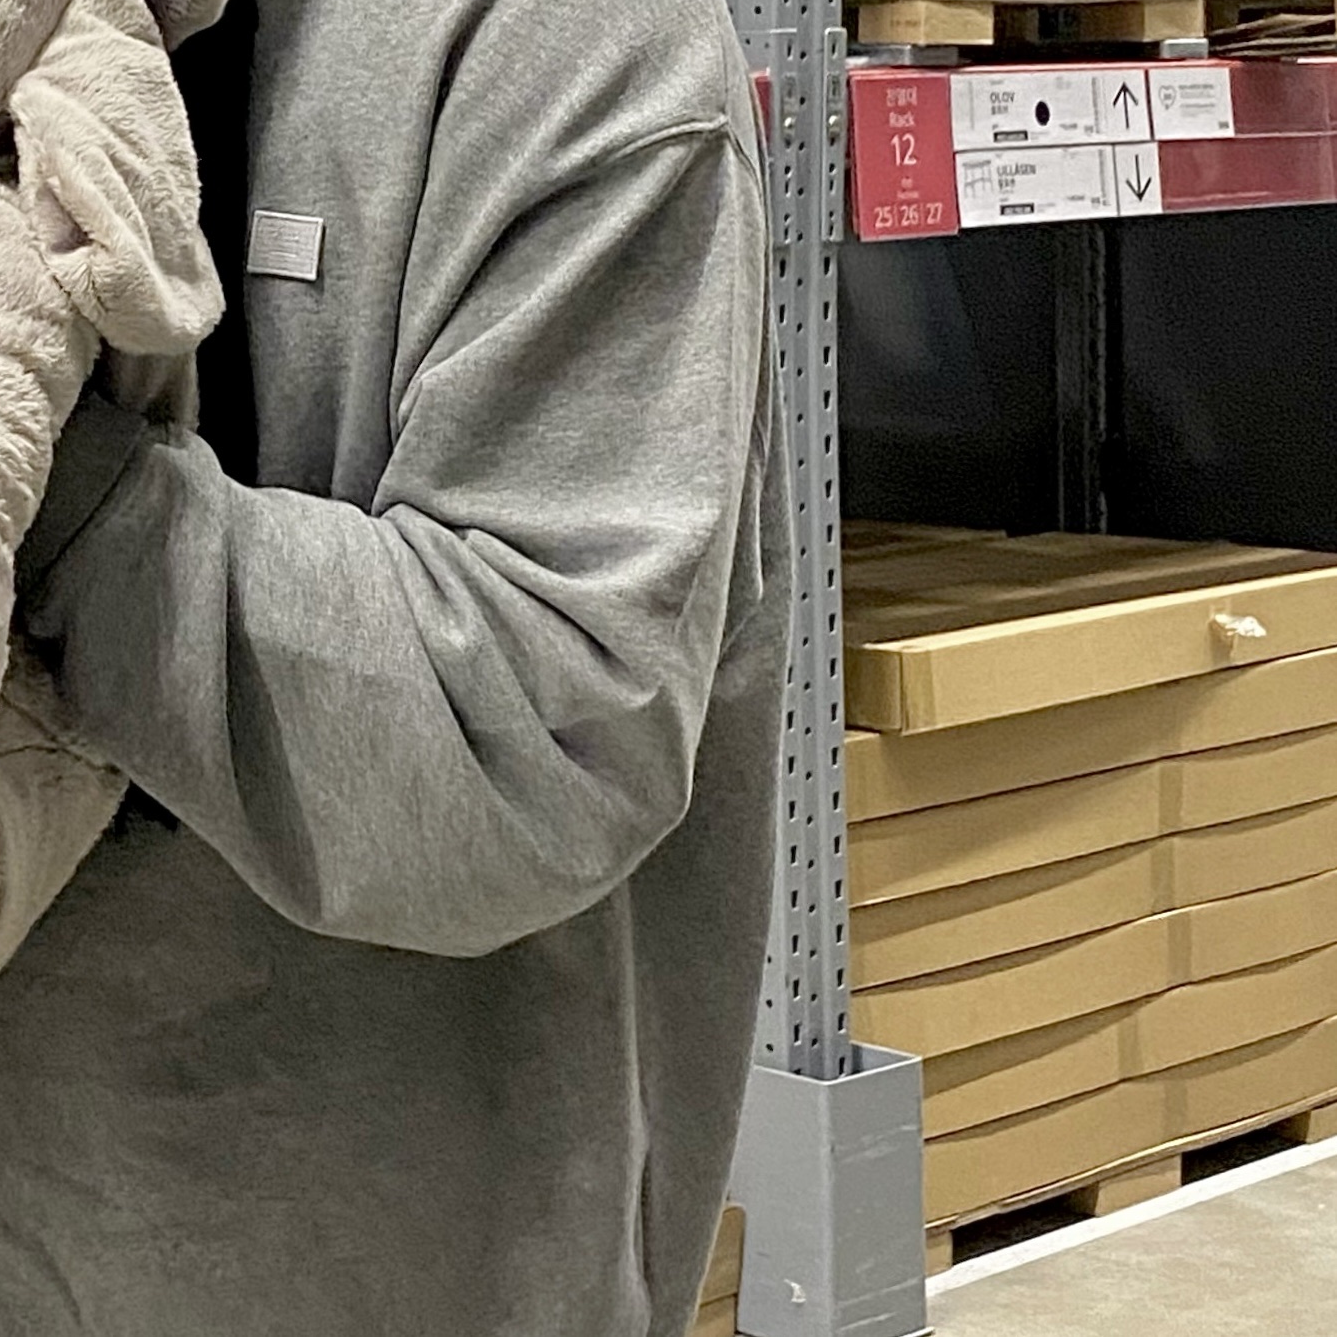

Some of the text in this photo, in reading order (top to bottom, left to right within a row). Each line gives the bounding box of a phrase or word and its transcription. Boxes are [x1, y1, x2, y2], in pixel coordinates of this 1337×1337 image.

[990, 91, 1016, 103] OLOV
[889, 111, 916, 128] Rack
[890, 133, 917, 166] 12
[874, 203, 943, 228] 25 26 27
